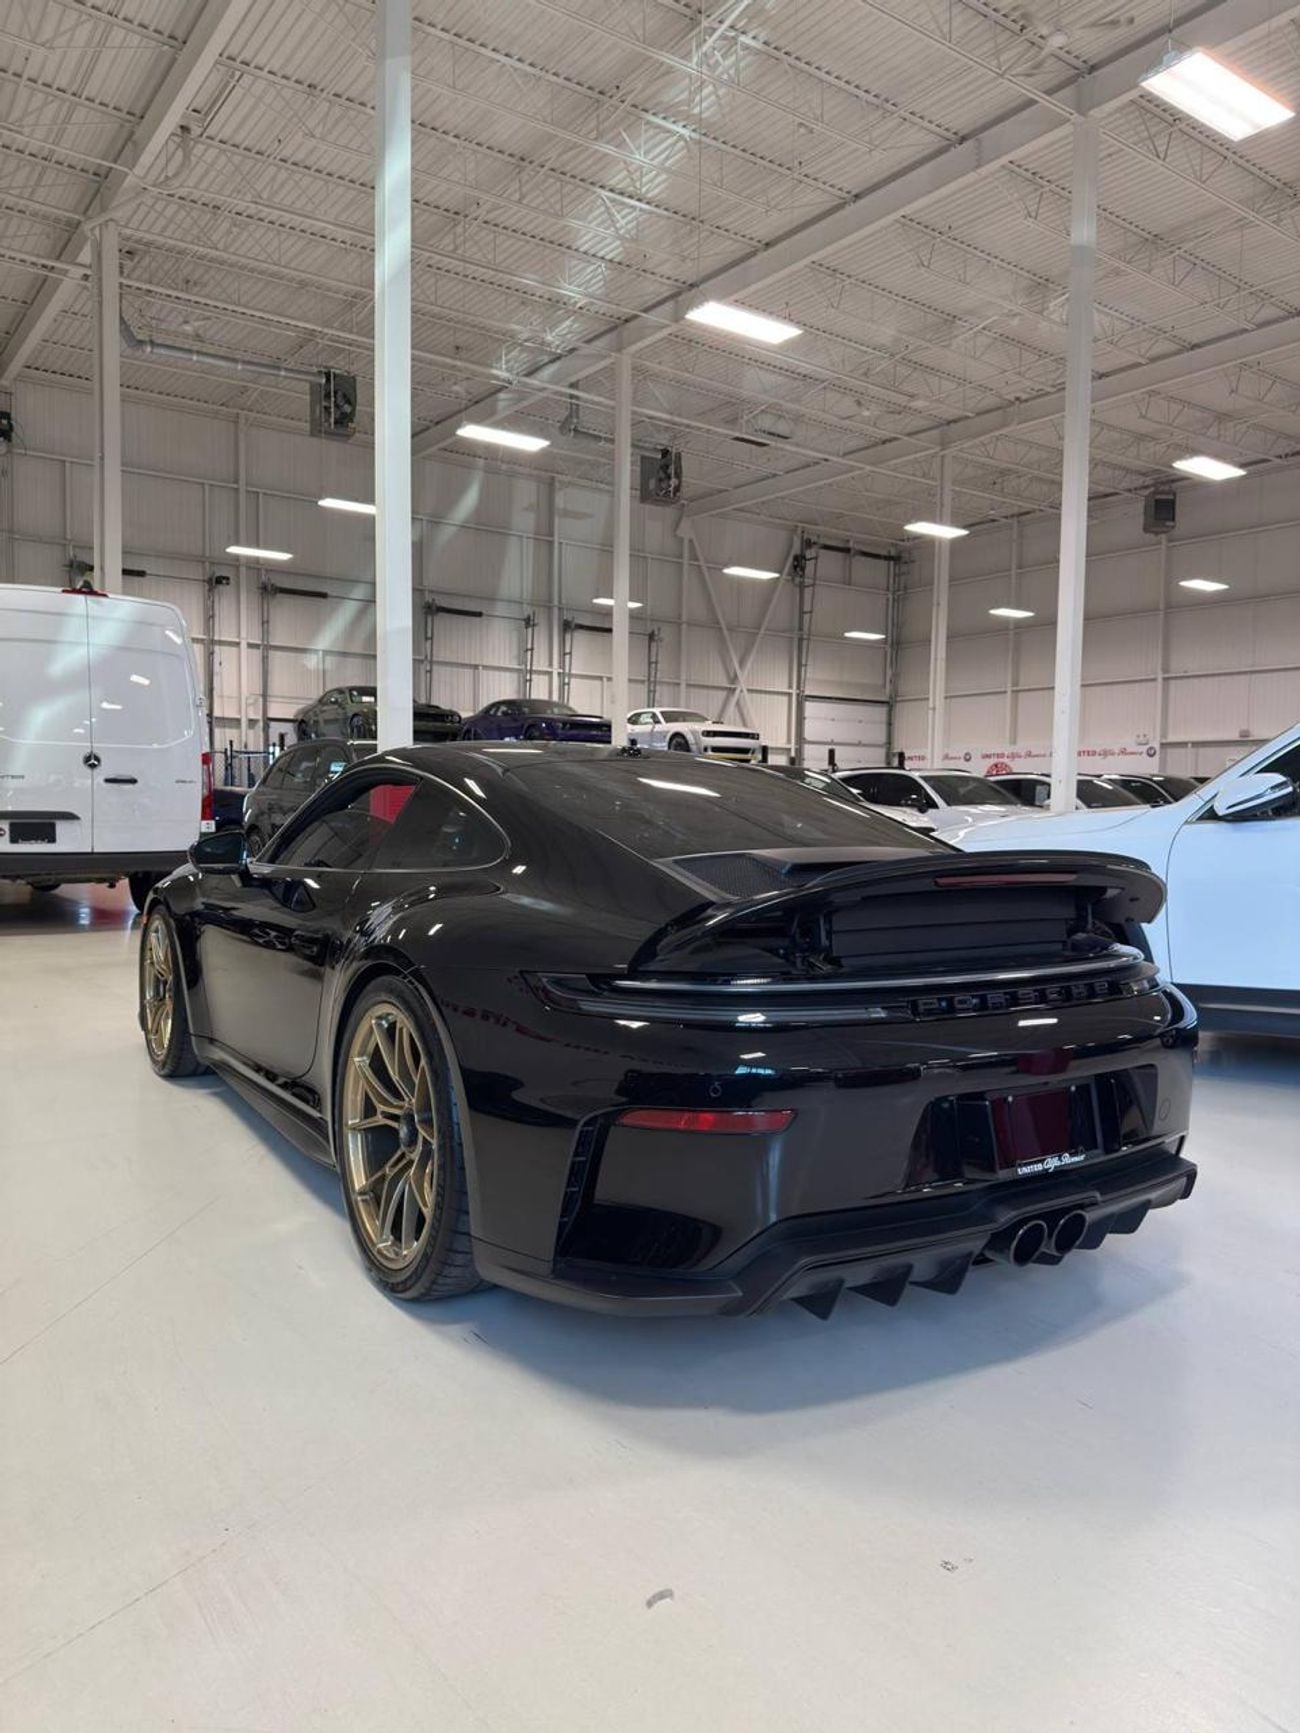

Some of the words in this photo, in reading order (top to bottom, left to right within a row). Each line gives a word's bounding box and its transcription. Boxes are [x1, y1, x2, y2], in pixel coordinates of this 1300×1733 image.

[981, 752, 1005, 760] UNITED
[919, 982, 1108, 1012] PORSCHE
[1017, 1163, 1043, 1175] UNITED
[1043, 1157, 1061, 1172] Alfa
[1061, 1153, 1086, 1166] Romeo
